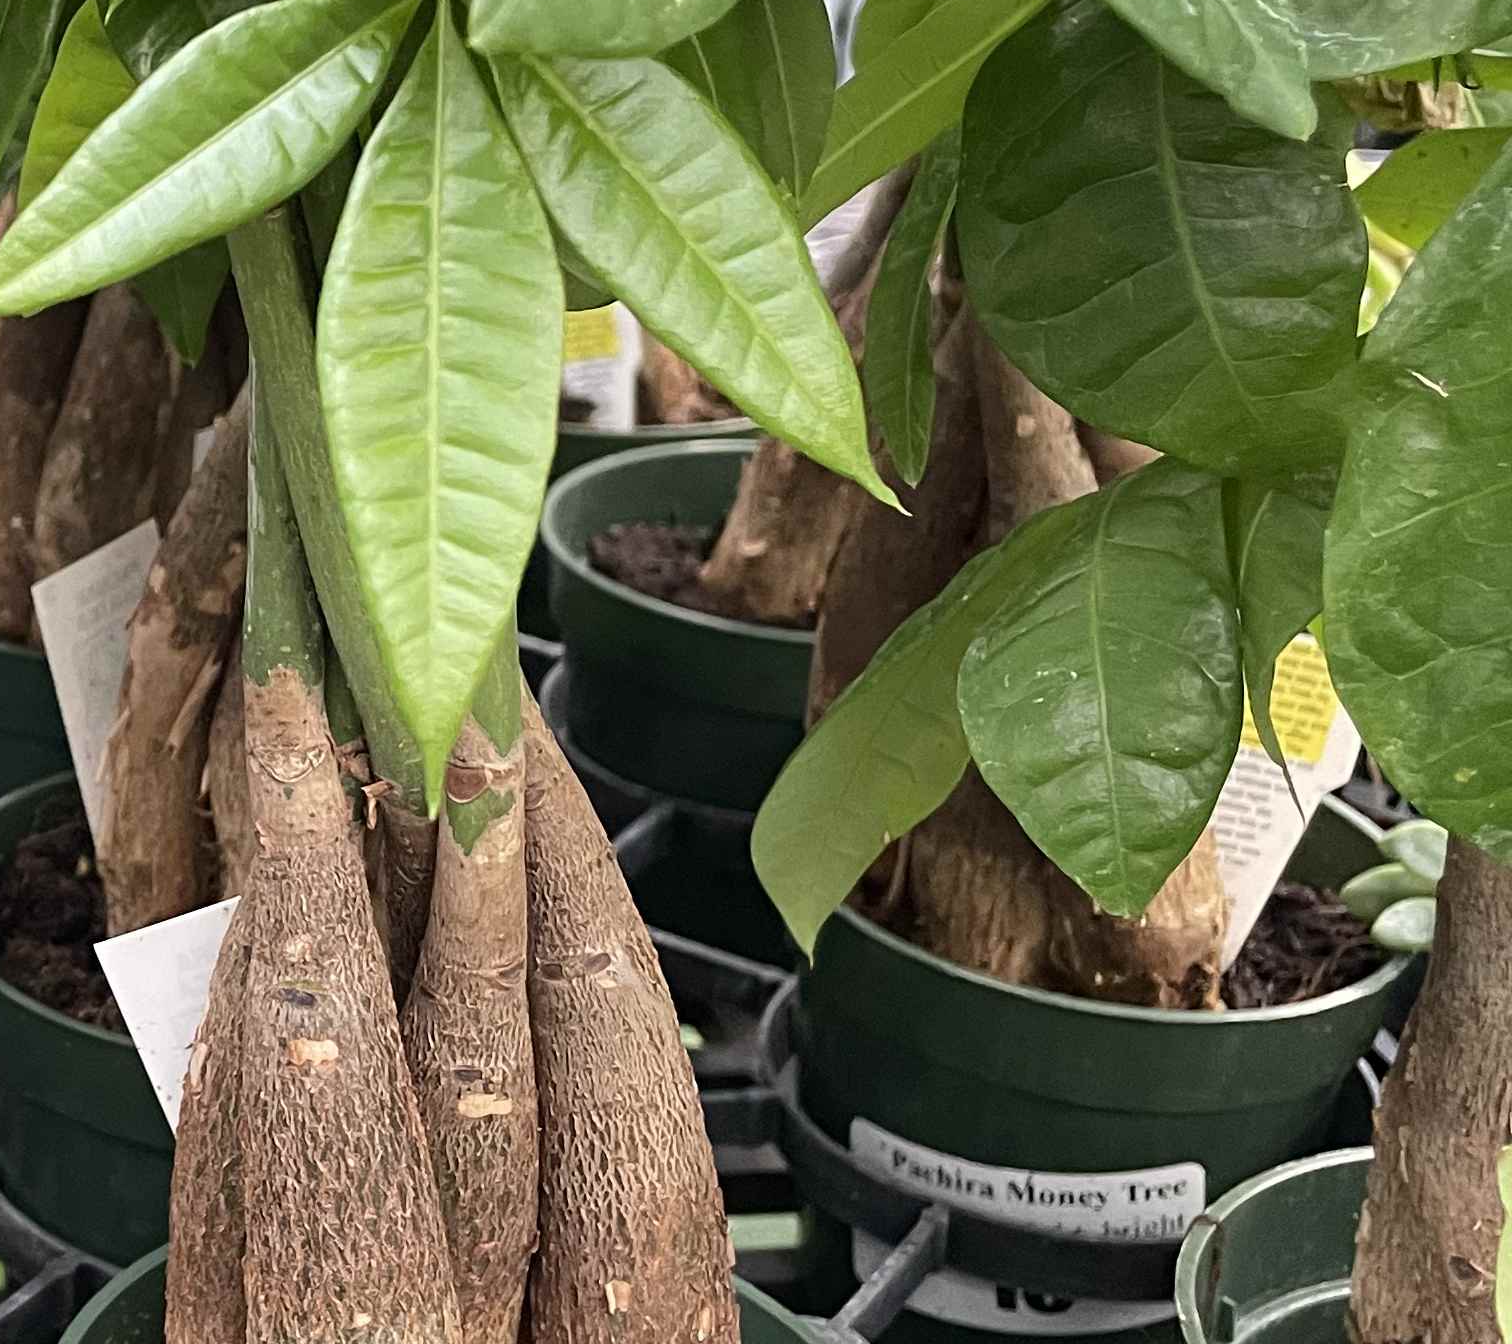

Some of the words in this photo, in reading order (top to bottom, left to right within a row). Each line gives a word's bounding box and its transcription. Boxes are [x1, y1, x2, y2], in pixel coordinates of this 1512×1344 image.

[893, 1150, 994, 1199] Pachira
[1008, 1180, 1110, 1212] Money
[1122, 1180, 1187, 1202] Tree
